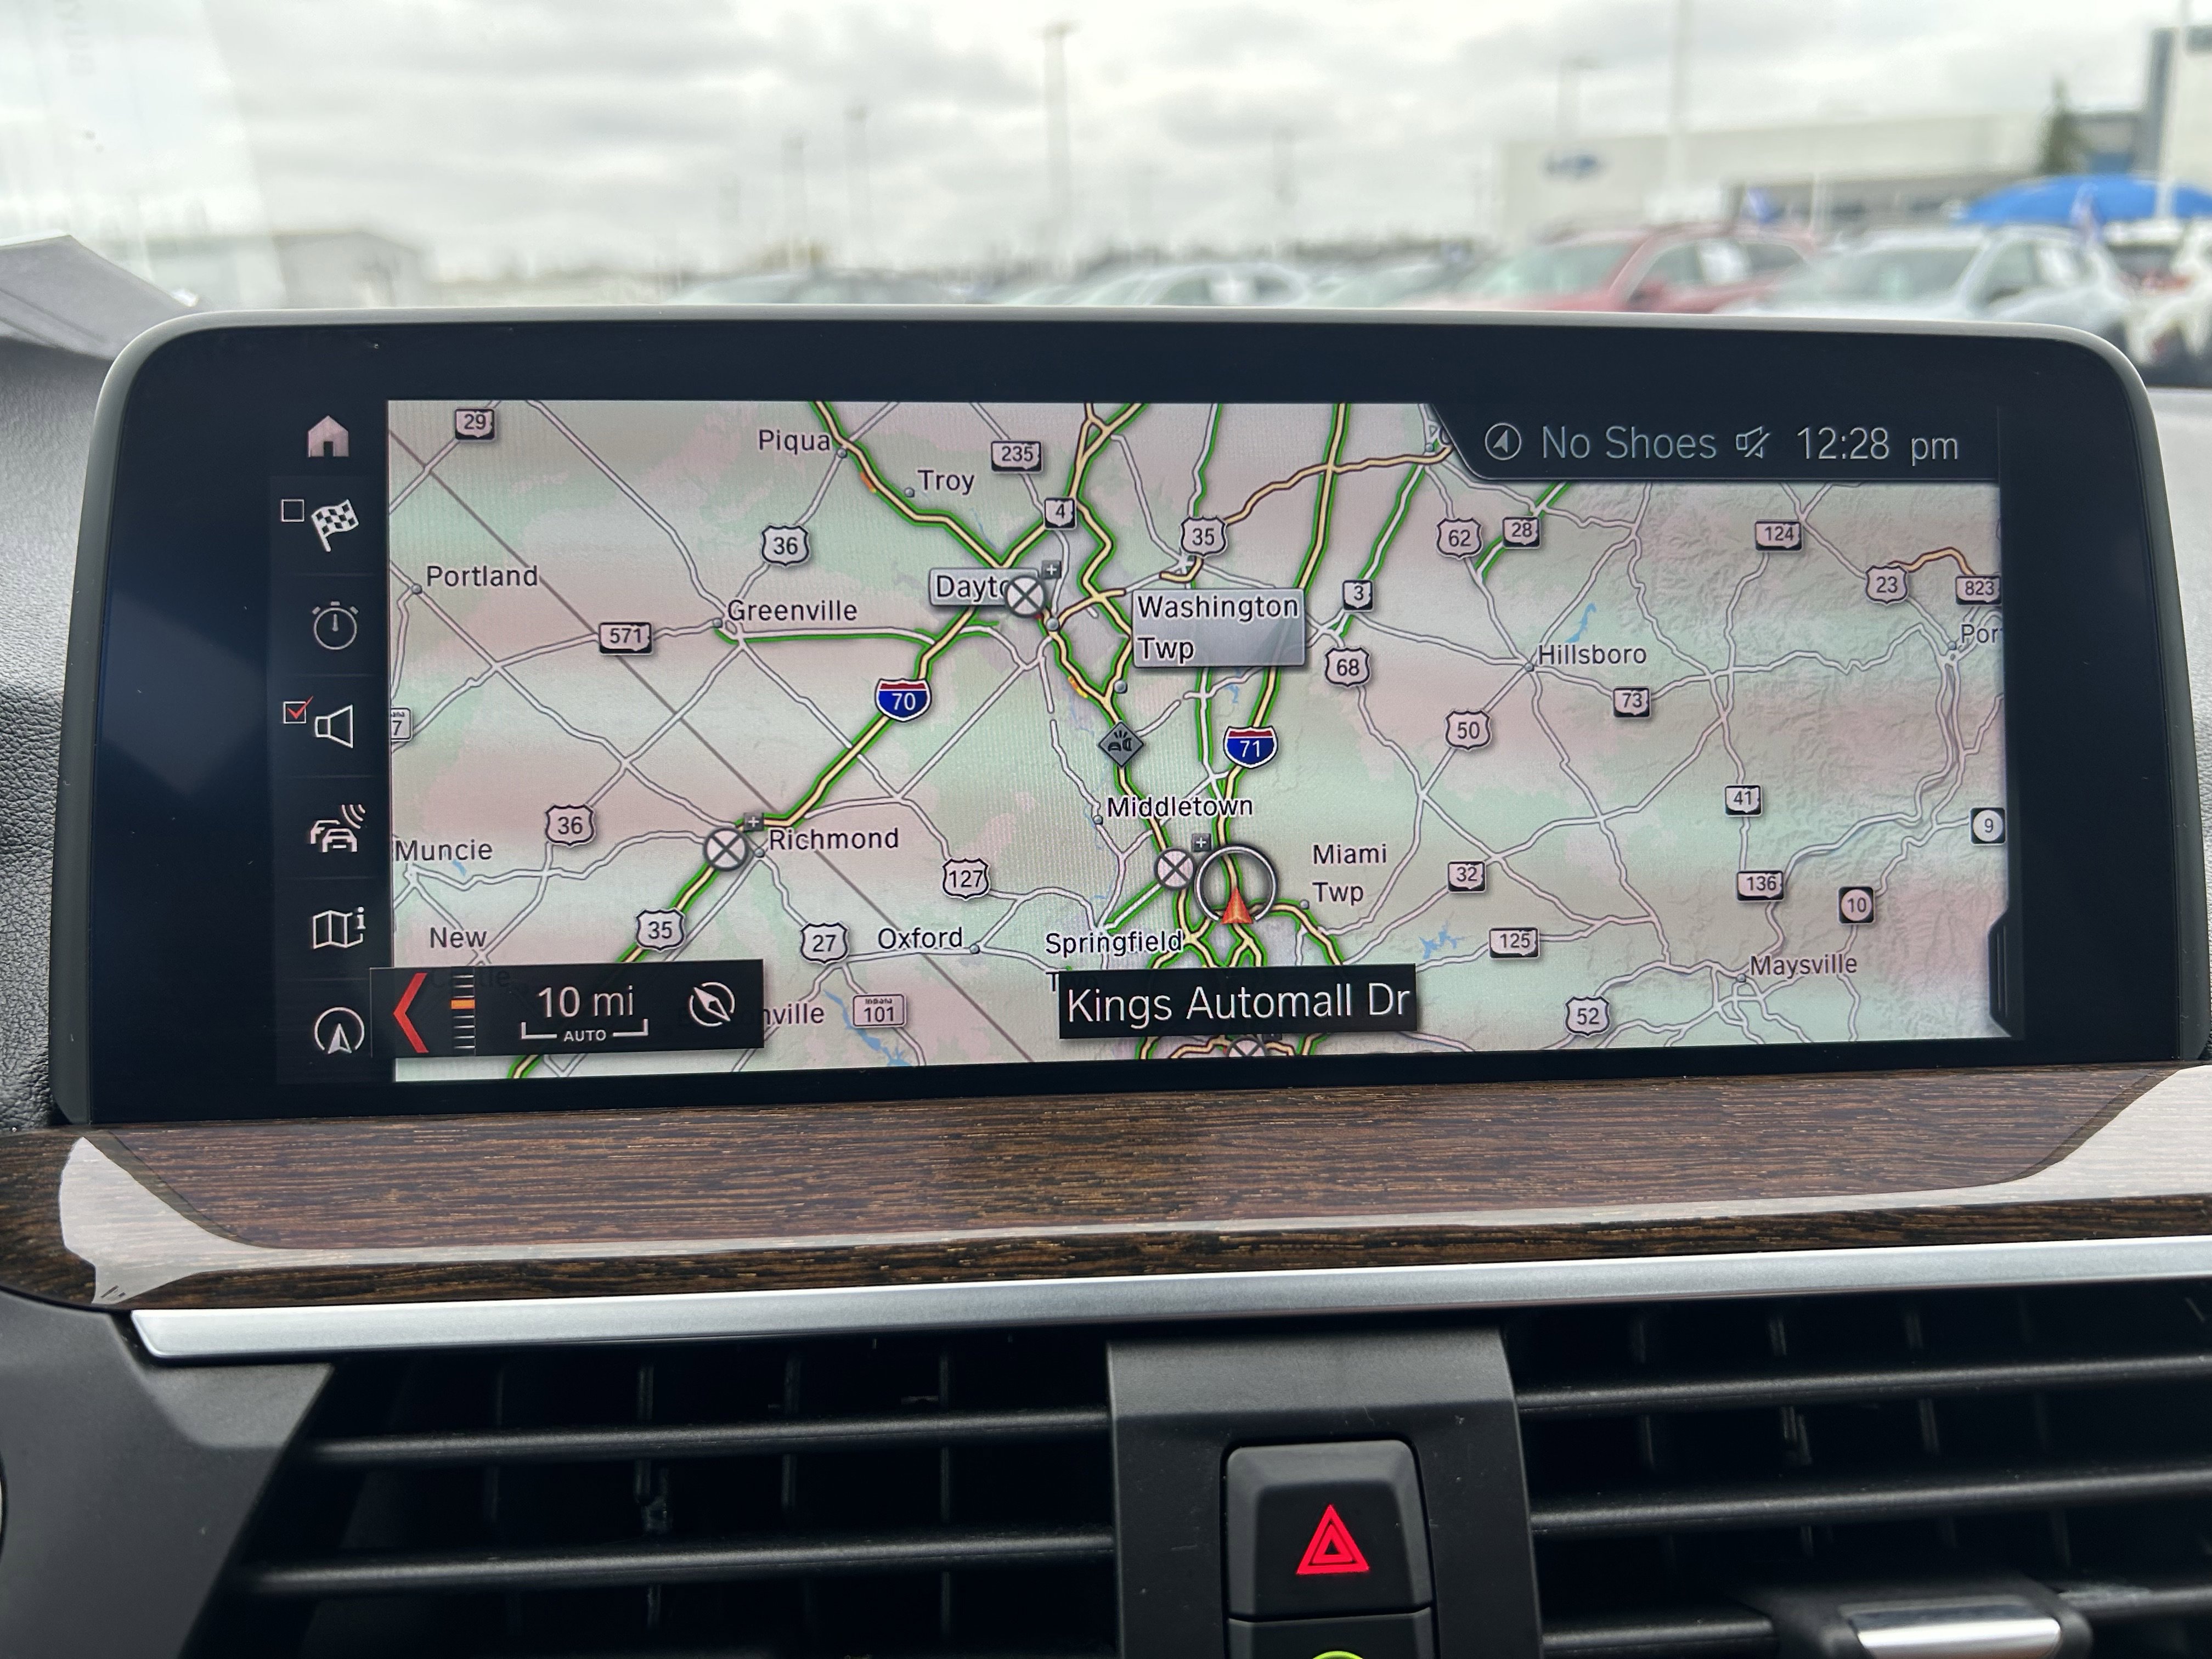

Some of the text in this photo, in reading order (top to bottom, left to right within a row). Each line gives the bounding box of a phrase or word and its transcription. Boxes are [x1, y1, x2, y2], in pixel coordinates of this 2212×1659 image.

[465, 414, 486, 430] 29
[759, 430, 831, 456] Piqua
[1542, 426, 1716, 459] No Shoes
[1798, 428, 1958, 466] 12:28 pm
[1002, 447, 1033, 462] 235
[918, 470, 974, 494] Troy
[1056, 505, 1065, 518] 4
[1193, 529, 1214, 546] 35
[1449, 531, 1470, 546] 62
[1512, 523, 1532, 537] 28
[1765, 527, 1794, 541] 124
[774, 538, 797, 554] 36
[427, 566, 538, 586] Portland
[937, 575, 1009, 602] Dayt
[1355, 586, 1363, 600] 3
[1876, 577, 1897, 593] 23
[1965, 580, 1994, 595] 823
[727, 601, 857, 621] Greenville
[1138, 596, 1297, 621] Washington
[610, 629, 641, 644] 571
[1961, 624, 2002, 643] Por
[1138, 637, 1193, 662] Twp
[1539, 645, 1646, 664] Hillsboro
[1336, 659, 1359, 676] 68
[892, 693, 916, 710] 70
[1623, 693, 1642, 708] 73
[1457, 723, 1480, 740] 50
[1240, 741, 1261, 758] 71
[1733, 791, 1753, 805] 41
[1108, 797, 1252, 818] Middletown
[558, 817, 582, 834] 36
[1984, 819, 1994, 833] 9
[770, 828, 899, 850] Richmond
[396, 840, 492, 861] Muncie
[1313, 844, 1387, 864] Miami
[950, 871, 983, 888] 127
[1457, 867, 1477, 881] 32
[1747, 877, 1776, 890] 136
[1313, 882, 1363, 905] Twp
[1848, 898, 1866, 913] 10
[430, 927, 487, 948] New
[648, 922, 672, 939] 35
[879, 927, 962, 949] Oxford
[813, 935, 835, 952] 27
[1046, 931, 1181, 958] Springfield
[1500, 934, 1530, 948] 125
[1751, 955, 1857, 981] Maysville
[538, 986, 633, 1017] 10 mi
[1068, 983, 1410, 1029] Kings Automall Dr
[864, 1006, 893, 1022] 101
[1577, 1008, 1600, 1025] 52
[564, 1030, 606, 1042] AUTO
